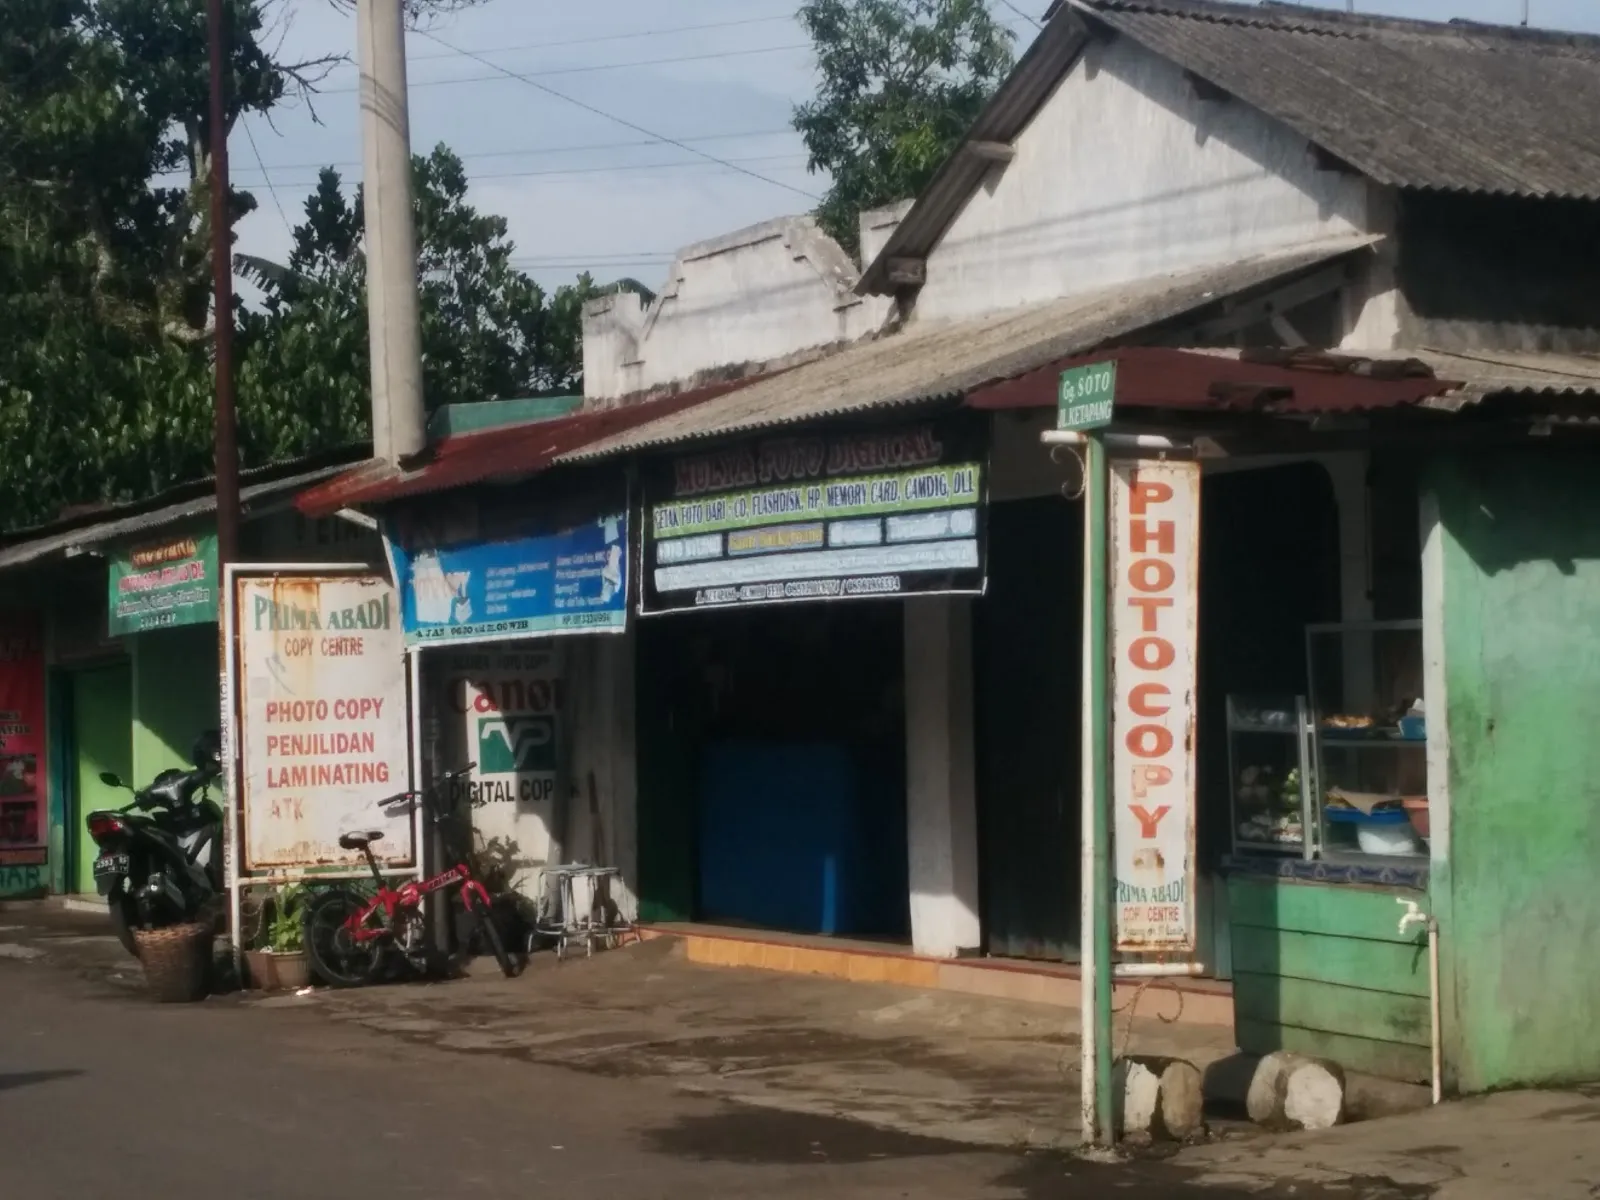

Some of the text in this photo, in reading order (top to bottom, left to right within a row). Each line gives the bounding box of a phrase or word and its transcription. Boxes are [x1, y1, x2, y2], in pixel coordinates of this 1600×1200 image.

[1077, 371, 1110, 397] SOTO
[758, 438, 824, 483] FOTO
[827, 427, 943, 475] DIGITAL
[681, 503, 704, 526] FOTO
[827, 483, 867, 508] MEMORY
[954, 469, 975, 494] DLL
[254, 594, 321, 631] PRIMA
[327, 592, 390, 631] ABADI
[285, 637, 364, 656] COPY CENTRE
[1126, 481, 1176, 839] PHOTOCOPY
[266, 697, 384, 722] PHOTO COPY
[266, 731, 375, 757] PENJILIDAN
[267, 762, 388, 788] LAMINATING
[451, 780, 516, 803] DIGITAL
[1150, 877, 1184, 903] ABADI
[1148, 905, 1180, 922] CENTRE
